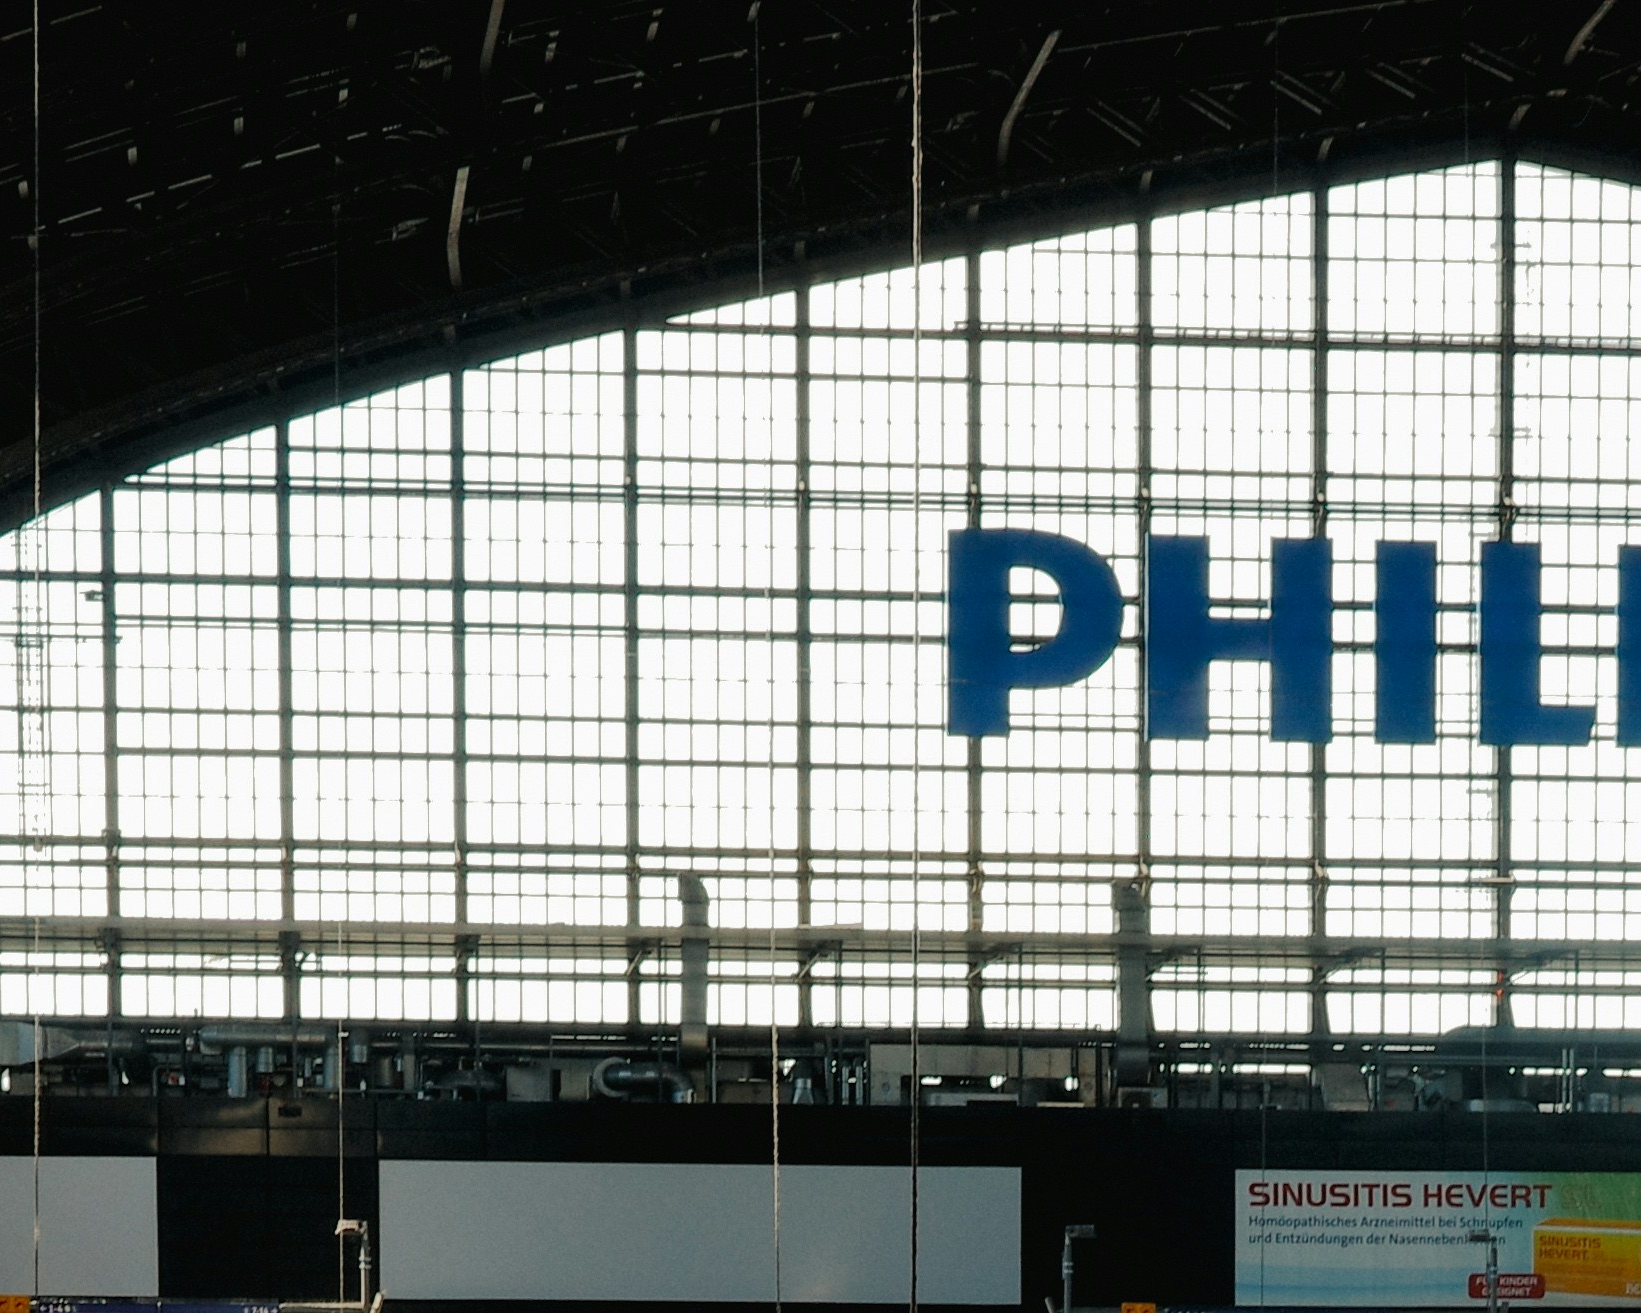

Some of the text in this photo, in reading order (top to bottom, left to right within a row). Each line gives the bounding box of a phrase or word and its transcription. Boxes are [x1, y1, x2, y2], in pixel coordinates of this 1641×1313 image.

[1248, 1182, 1412, 1208] SINUSITIS
[1423, 1183, 1553, 1209] HEVERT
[1248, 1216, 1523, 1232] Homöopathisches Arzneimittel bei Schnupfen
[1248, 1233, 1272, 1245] und
[1275, 1232, 1363, 1248] Entzündungen
[1367, 1233, 1386, 1245] der
[1539, 1236, 1601, 1248] SINUSITIS
[1498, 1276, 1538, 1286] KINDER
